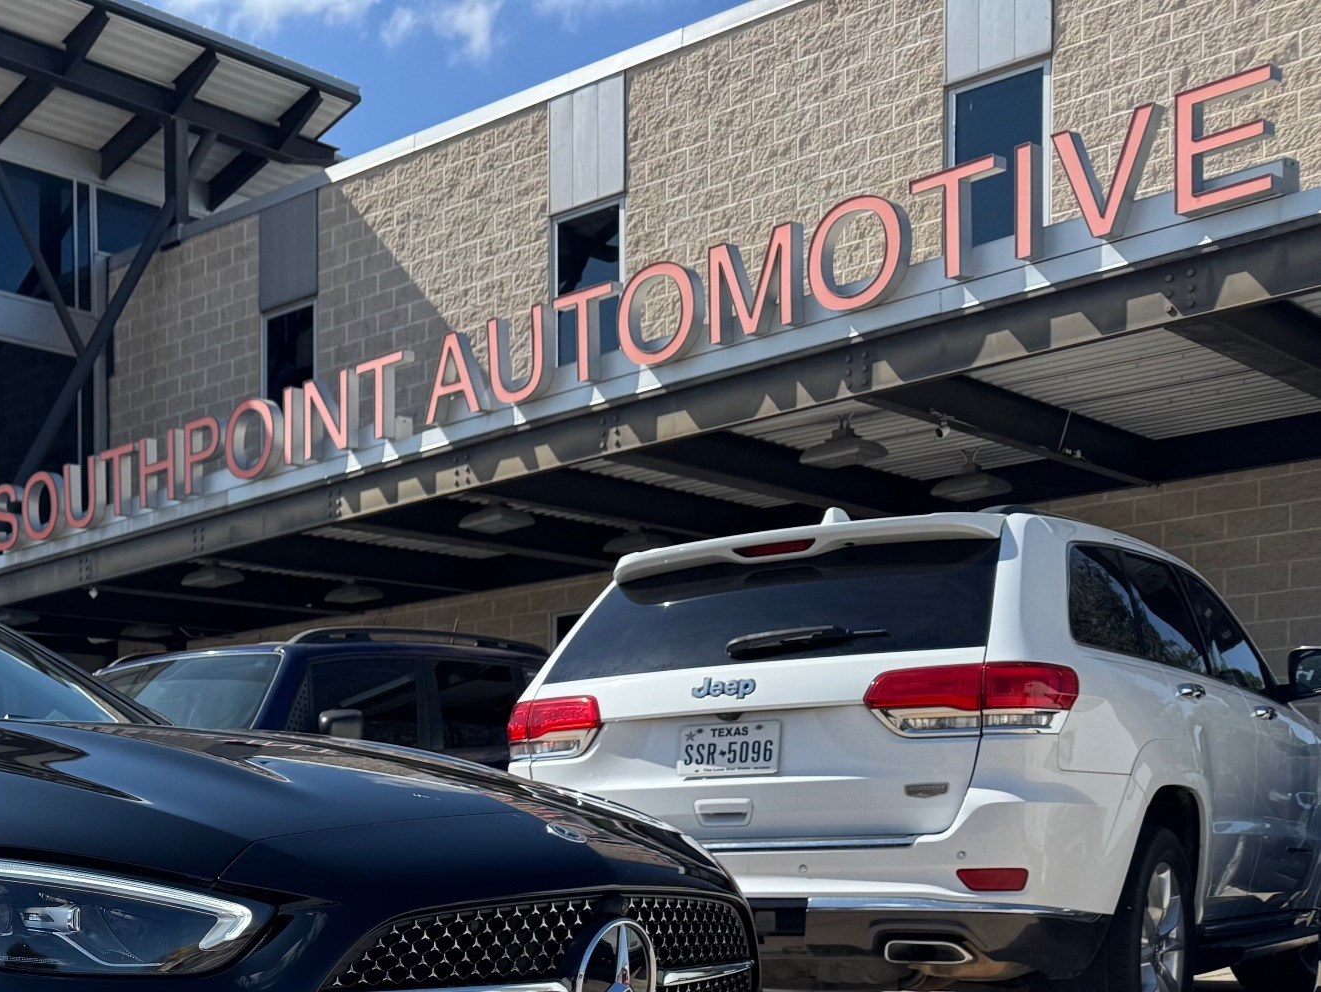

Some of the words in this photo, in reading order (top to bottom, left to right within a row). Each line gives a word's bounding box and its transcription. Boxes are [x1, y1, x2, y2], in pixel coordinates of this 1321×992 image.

[424, 62, 1278, 425] AUTOMOTIVE
[691, 677, 756, 700] Jeep
[710, 726, 749, 738] TEXAS
